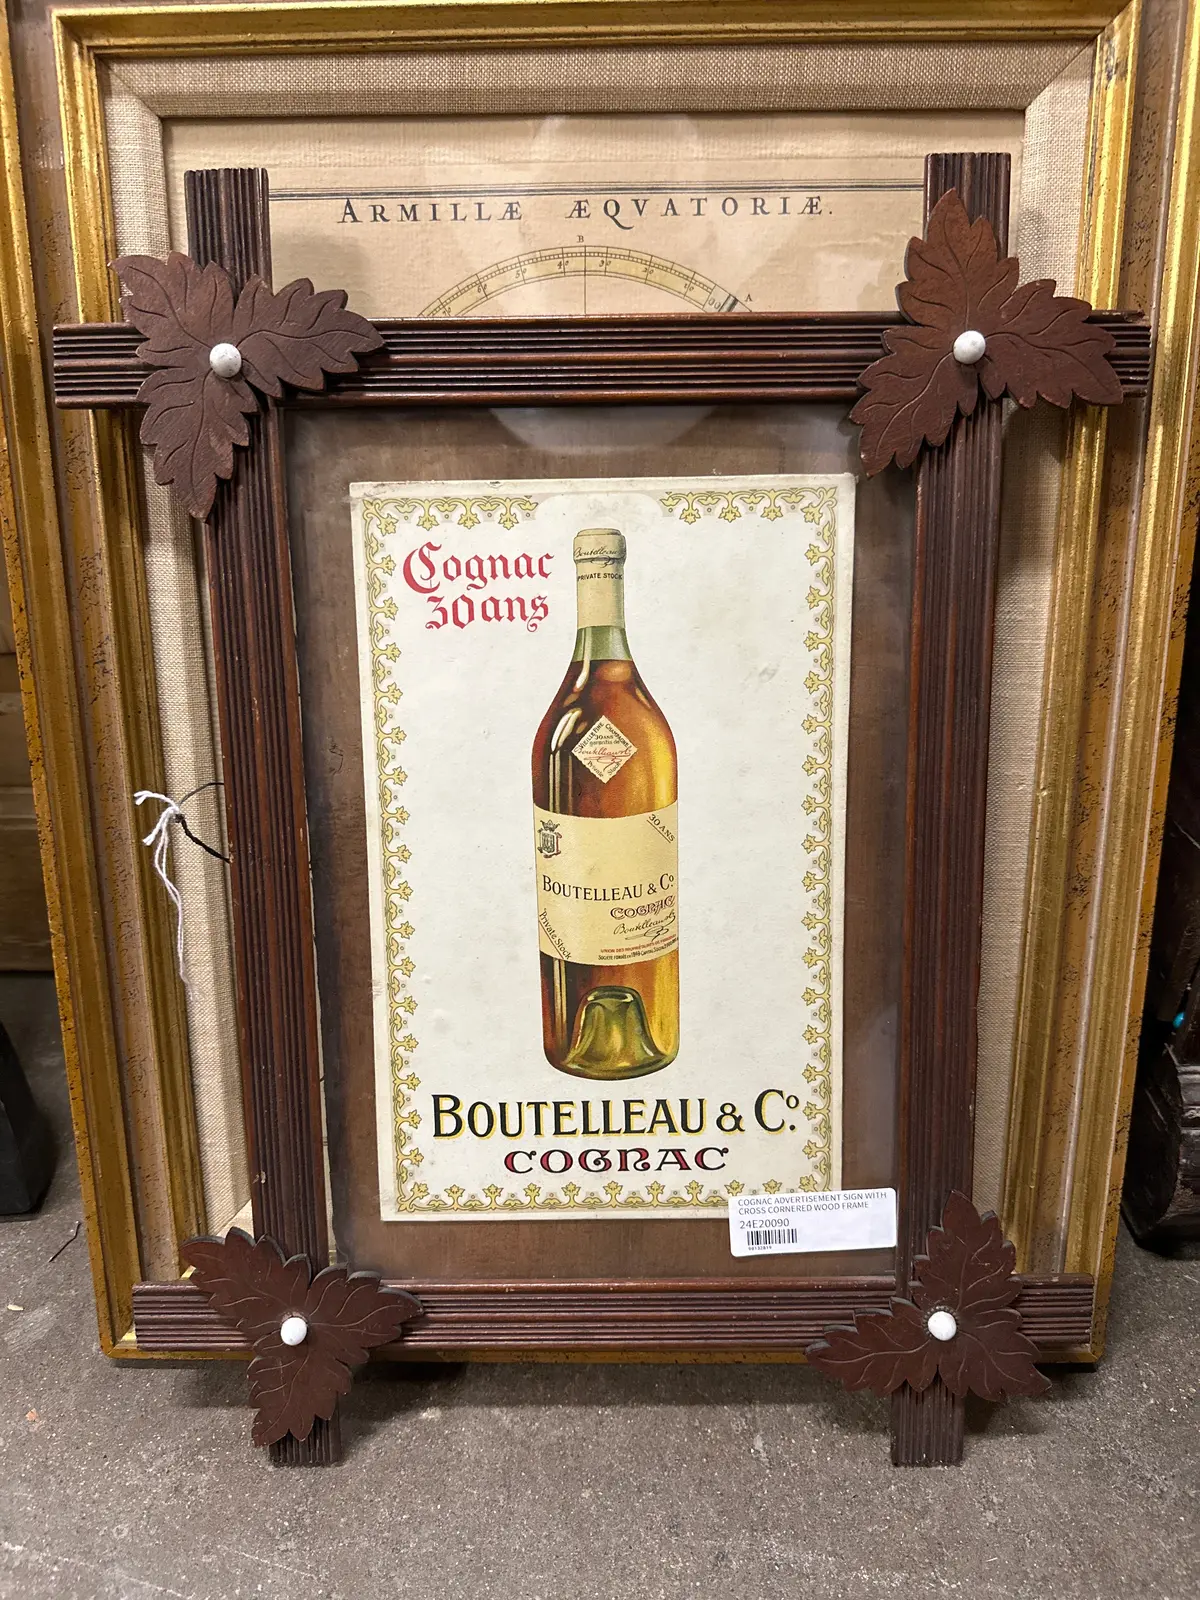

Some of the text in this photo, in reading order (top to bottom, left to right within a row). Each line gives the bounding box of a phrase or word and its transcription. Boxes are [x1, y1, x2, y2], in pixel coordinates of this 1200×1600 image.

[337, 198, 522, 224] ARMILLÆ
[577, 235, 584, 243] B
[403, 541, 554, 594] Cognac
[577, 573, 601, 581] PRIVATE
[542, 874, 642, 901] BOUTELLEAU
[647, 882, 657, 895] &
[610, 895, 675, 920] COGNAC
[555, 938, 572, 960] Stock
[431, 1094, 706, 1140] BOUTELLEAU
[715, 1102, 745, 1135] &
[504, 1146, 729, 1174] COGNAC
[738, 1191, 887, 1207] COGNAC ADVERTISEMENT SIGN WITH
[738, 1201, 869, 1215] CROSS CORNERED WOOD FRAME
[740, 1218, 790, 1229] 24E20090
